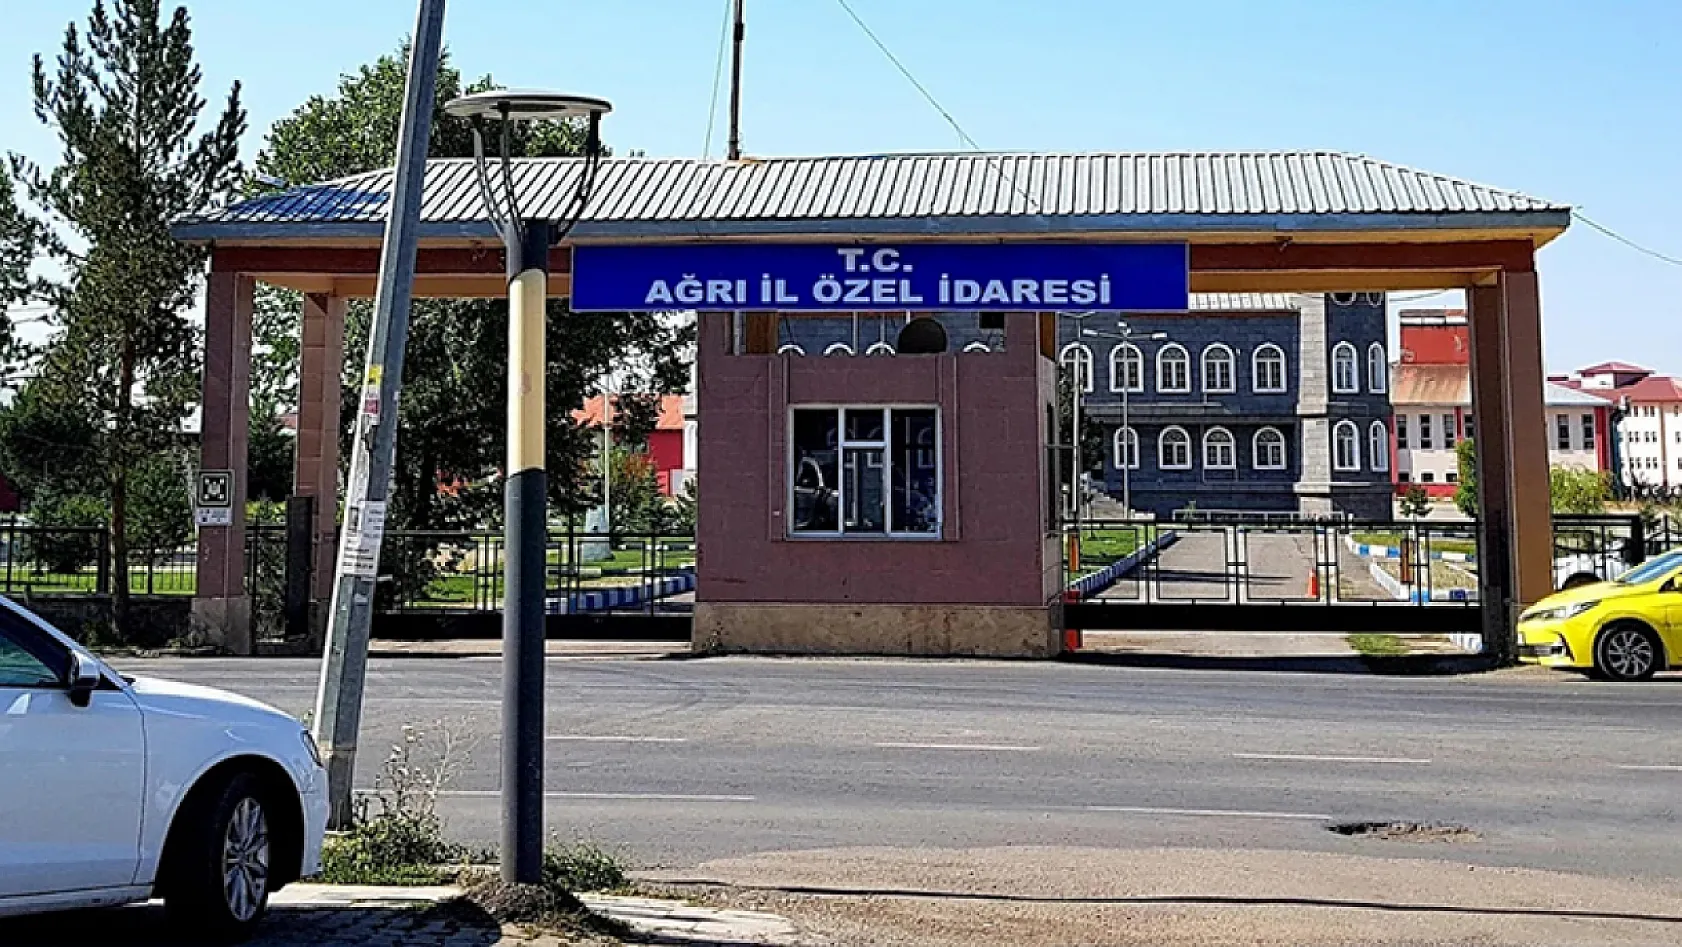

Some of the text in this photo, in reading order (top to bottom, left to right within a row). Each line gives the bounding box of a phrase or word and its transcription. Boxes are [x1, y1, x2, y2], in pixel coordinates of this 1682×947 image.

[837, 248, 913, 273] T.C.
[644, 272, 1112, 304] AĞRI İL ÖZEL İDARESİ
